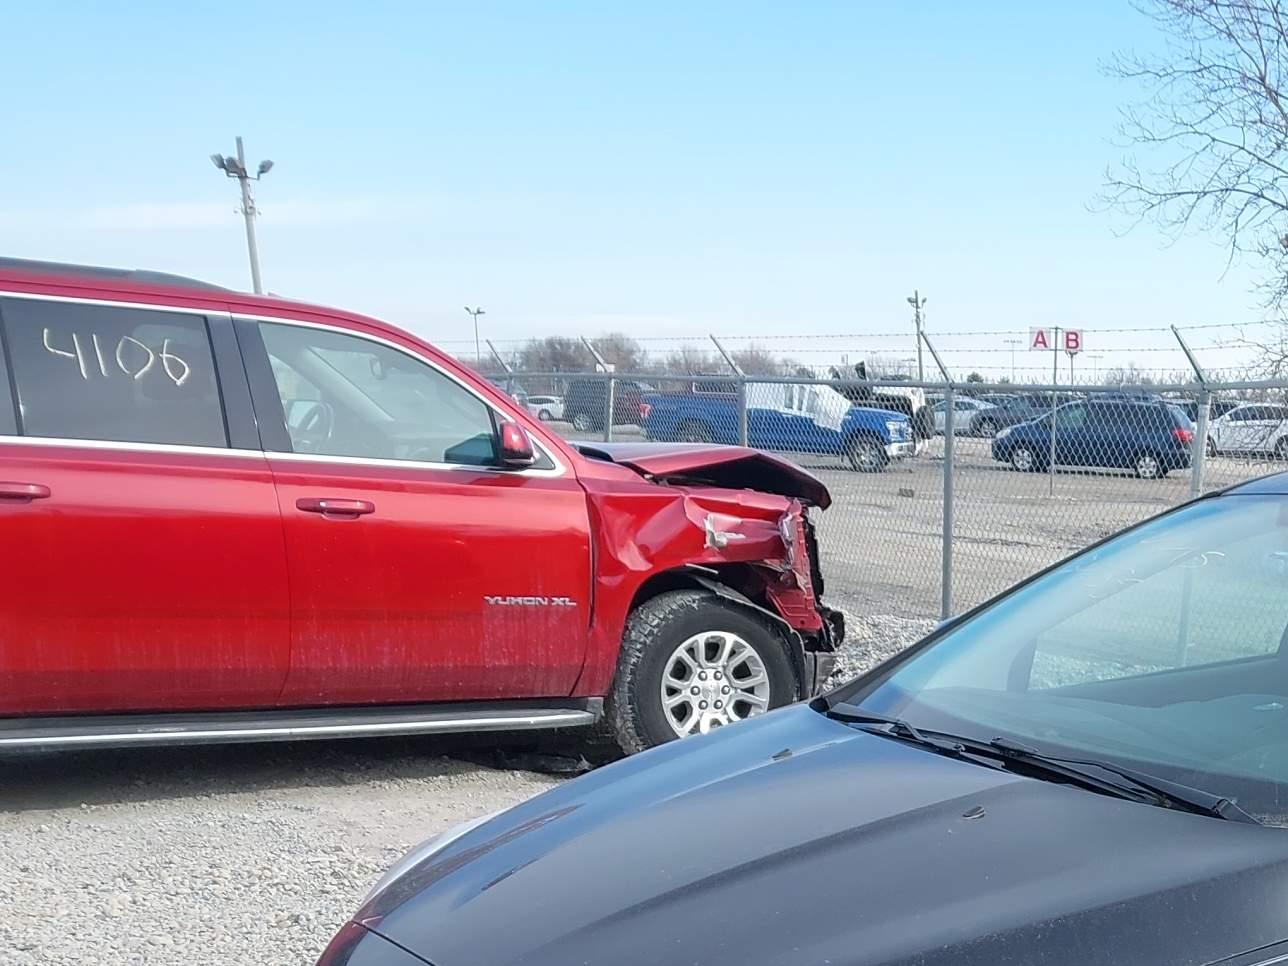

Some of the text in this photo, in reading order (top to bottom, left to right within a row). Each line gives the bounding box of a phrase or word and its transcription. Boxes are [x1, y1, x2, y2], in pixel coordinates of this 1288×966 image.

[1033, 330, 1048, 348] A
[1065, 331, 1080, 349] B
[43, 328, 190, 386] 4106
[483, 596, 577, 606] YUKON XL
